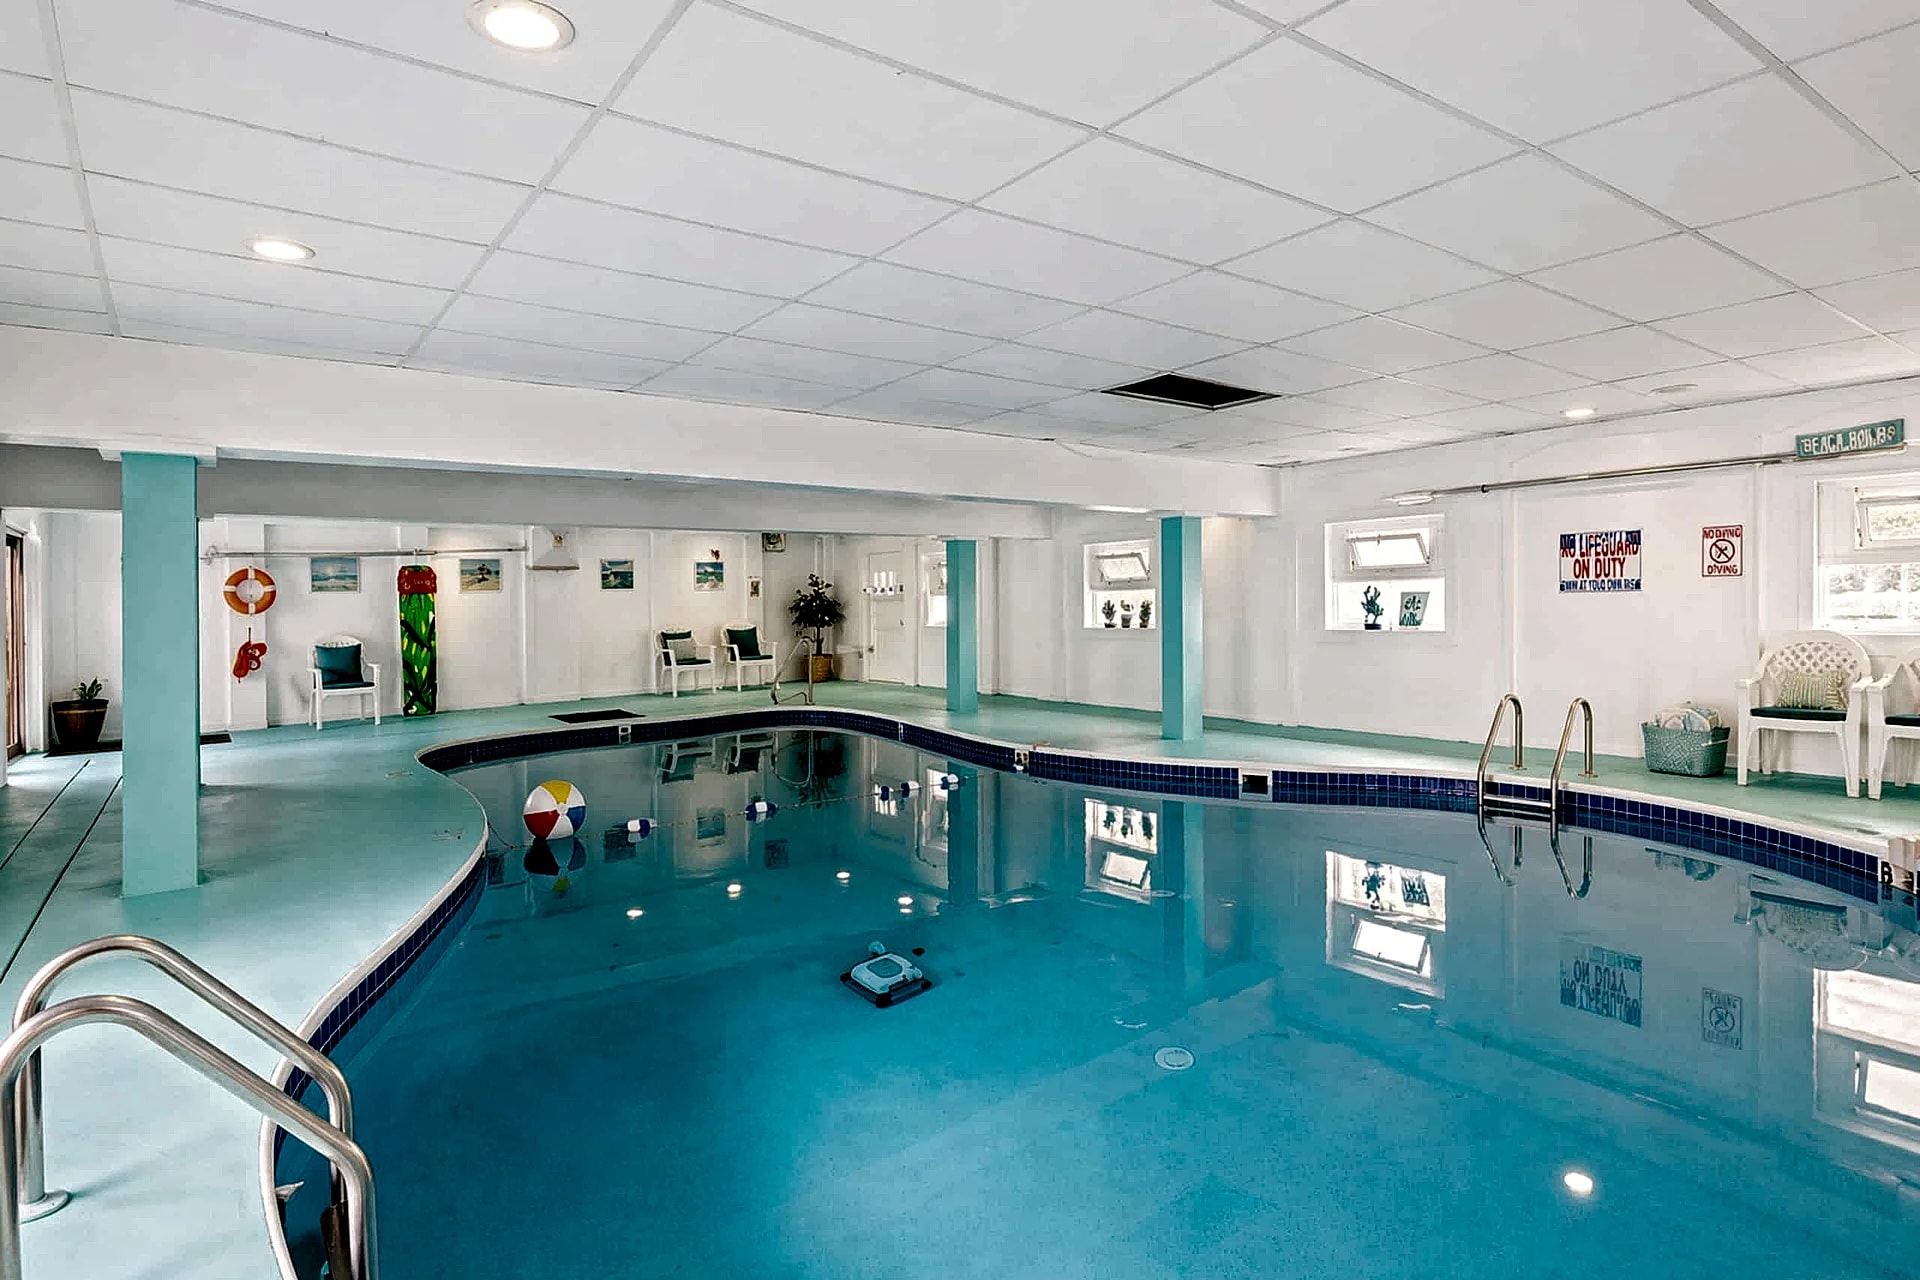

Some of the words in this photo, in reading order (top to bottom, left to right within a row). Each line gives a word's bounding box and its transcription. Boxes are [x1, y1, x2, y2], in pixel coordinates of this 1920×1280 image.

[1703, 529, 1714, 540] NO
[1560, 534, 1576, 557] NO
[1579, 531, 1640, 557] LIFEGUARD
[1573, 558, 1590, 579] ON
[1594, 557, 1626, 579] DUTY
[1707, 563, 1739, 575] DIVING
